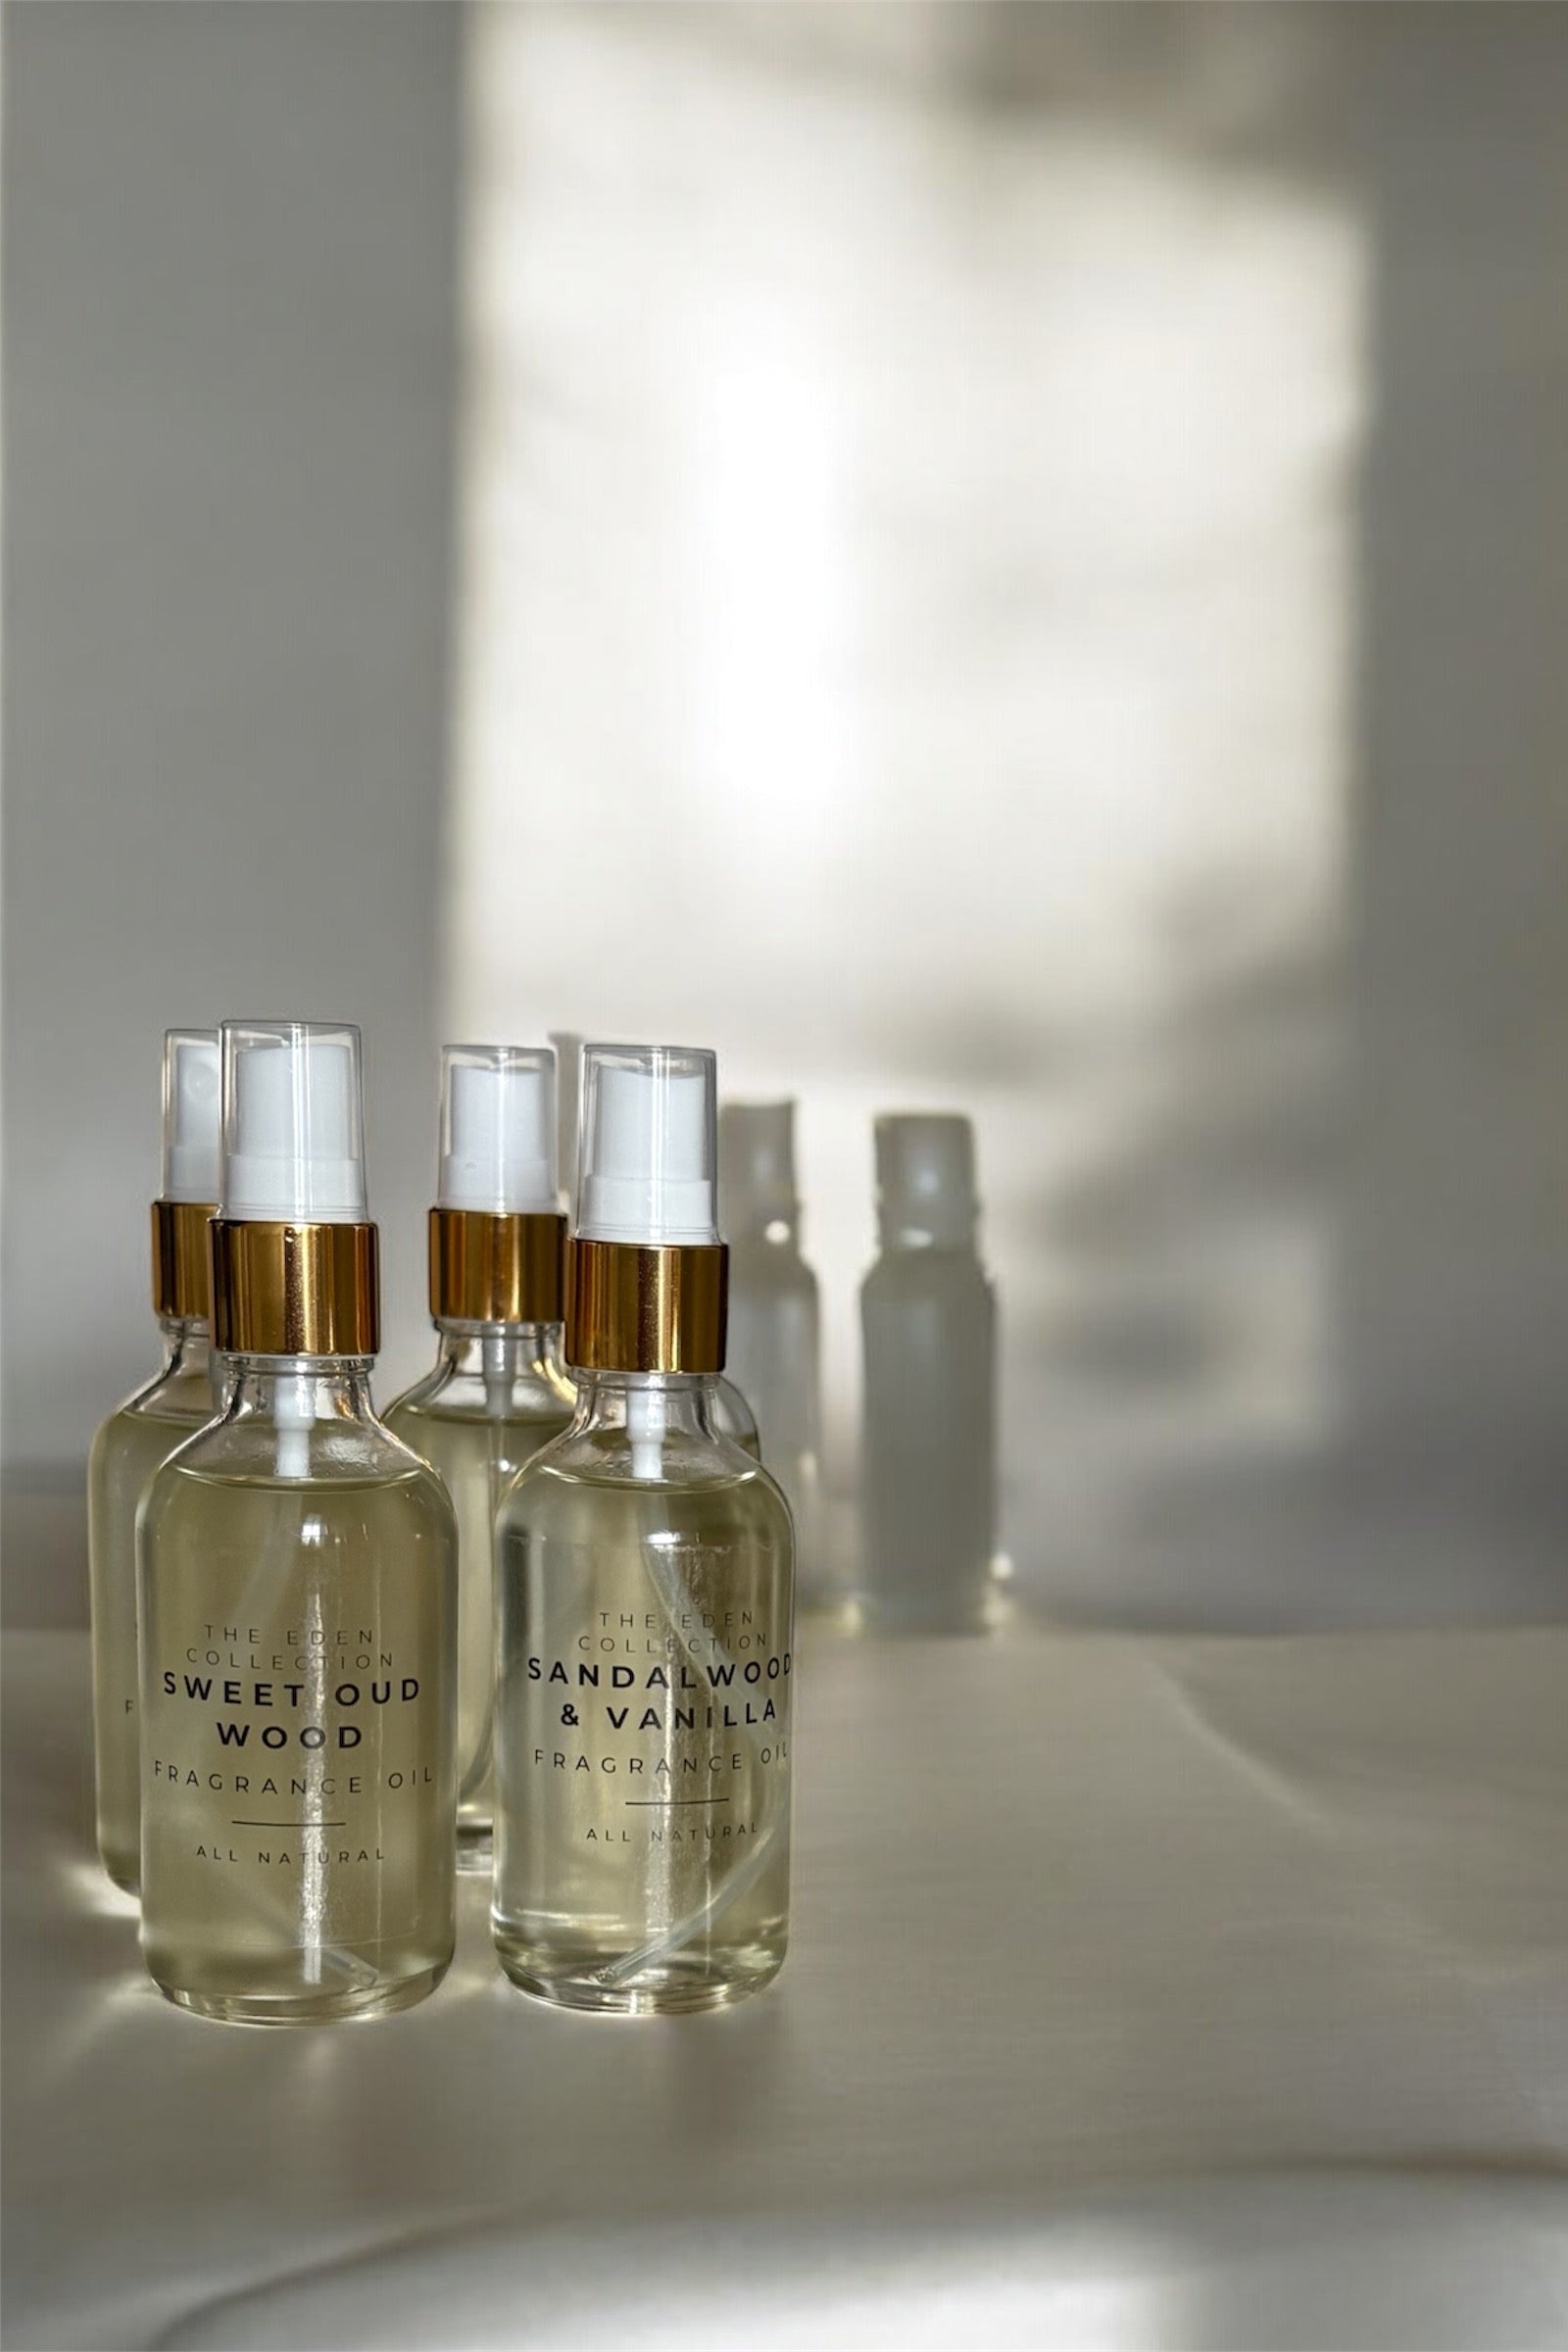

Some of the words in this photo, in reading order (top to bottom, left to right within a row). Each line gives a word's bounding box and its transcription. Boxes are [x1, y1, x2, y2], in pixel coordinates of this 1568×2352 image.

[599, 1612, 657, 1629] THE
[681, 1611, 753, 1629] EDEN
[204, 1624, 261, 1644] THE
[287, 1629, 373, 1645] EDEN
[578, 1633, 767, 1653] COLLECTION
[186, 1647, 392, 1671] COLLECTION
[527, 1653, 791, 1689] SANDALWOOD
[163, 1671, 304, 1707] SWEET
[334, 1678, 419, 1706] OUD
[561, 1703, 579, 1727] &
[606, 1698, 776, 1730] VANILLA
[216, 1721, 362, 1749] WOOD
[534, 1749, 742, 1775] FRAGRANCE
[760, 1741, 787, 1765] OIL
[154, 1760, 362, 1795] FRAGRANCE
[388, 1766, 432, 1789] OIL
[586, 1828, 631, 1842] ALL
[651, 1822, 758, 1842] NATURAL
[196, 1845, 237, 1862] ALL
[258, 1848, 385, 1864] NATURAL
